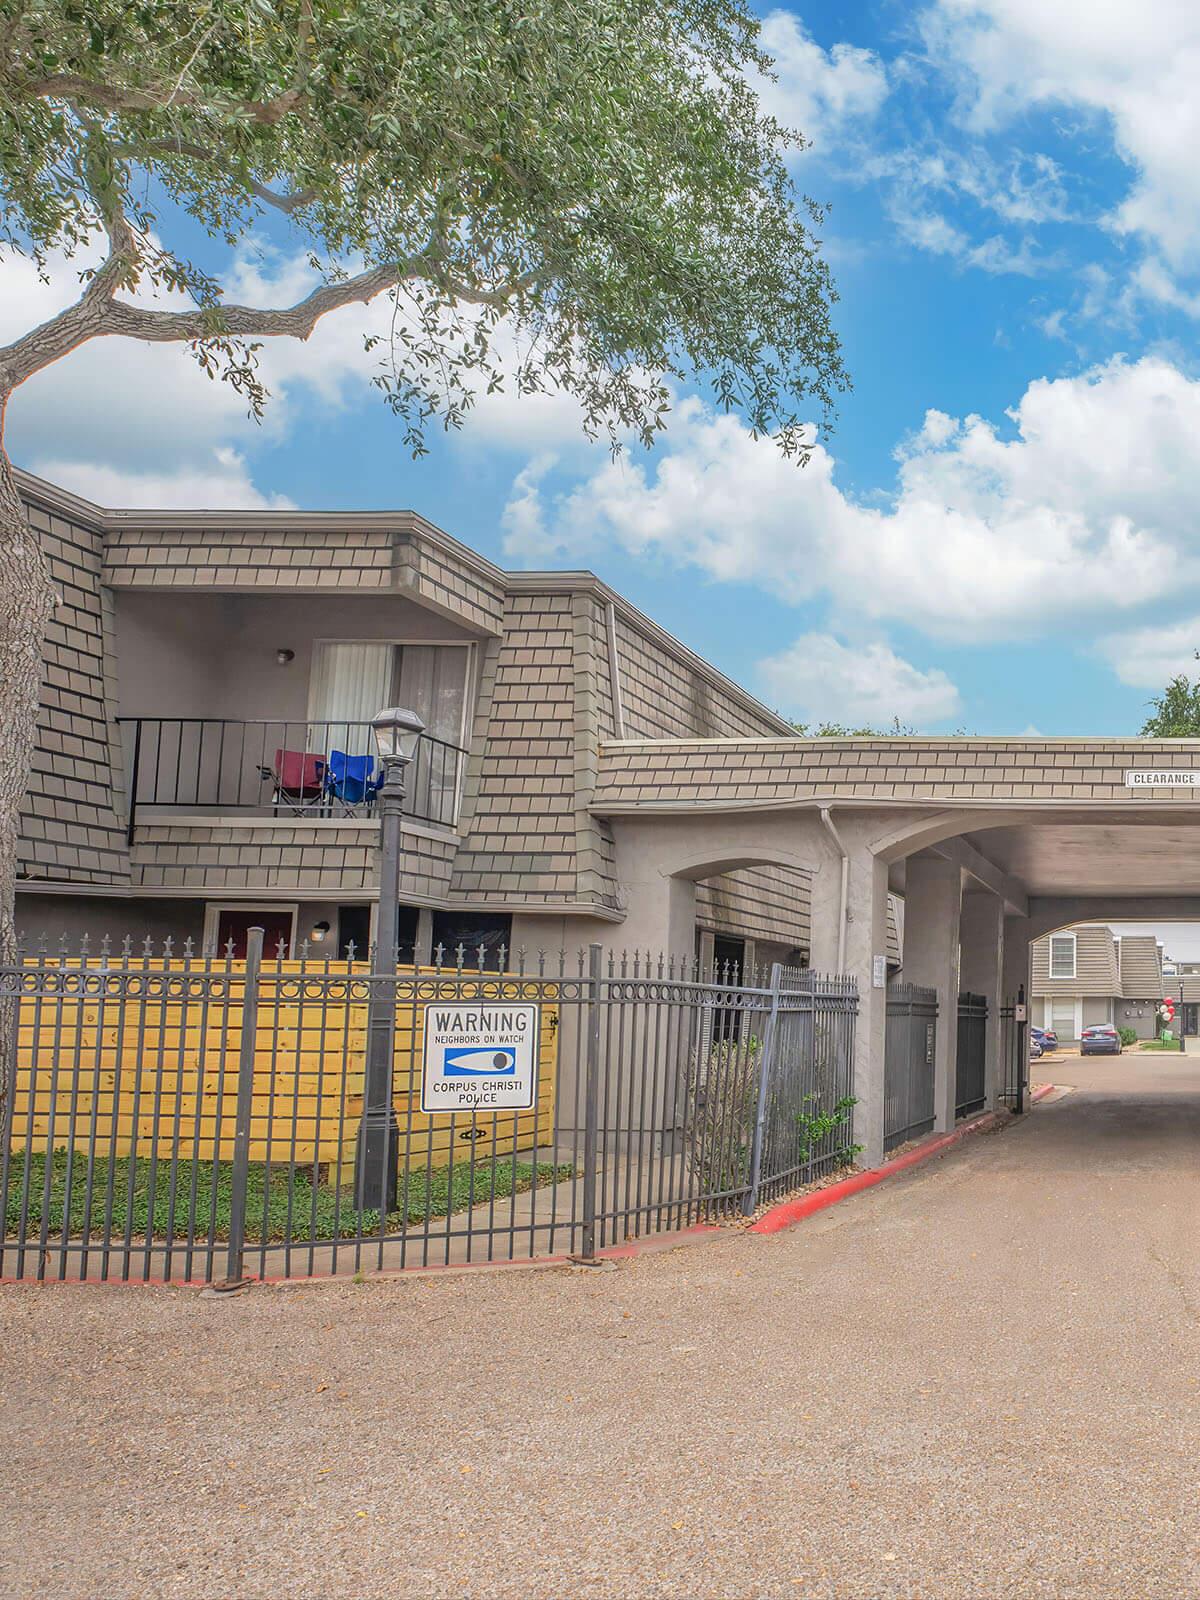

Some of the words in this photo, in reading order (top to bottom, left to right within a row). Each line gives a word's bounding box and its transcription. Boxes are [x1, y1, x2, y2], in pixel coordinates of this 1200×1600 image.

[1134, 774, 1194, 784] CLEARANCE
[436, 1012, 527, 1032] WARNING
[435, 1035, 480, 1044] NEIGHBORS
[484, 1035, 495, 1043] ON
[499, 1034, 524, 1043] WATCH
[433, 1082, 477, 1092] CORPUS
[482, 1081, 522, 1091] CHRISTI
[459, 1093, 497, 1103] POLICE
